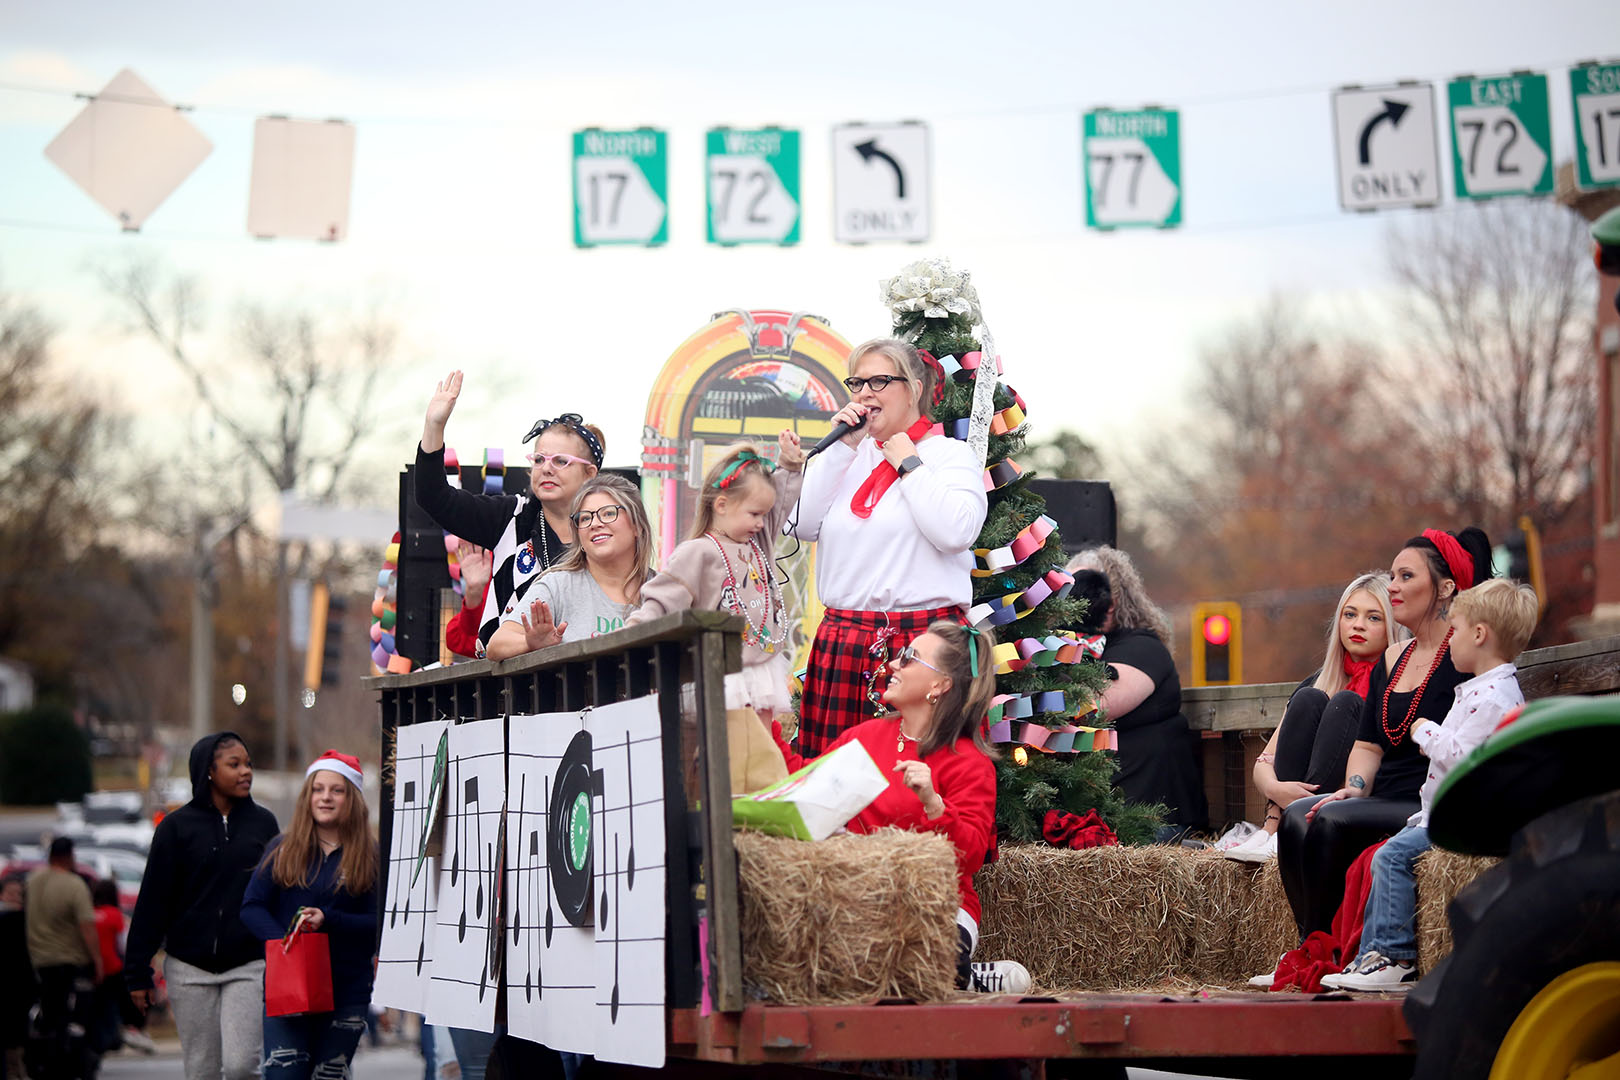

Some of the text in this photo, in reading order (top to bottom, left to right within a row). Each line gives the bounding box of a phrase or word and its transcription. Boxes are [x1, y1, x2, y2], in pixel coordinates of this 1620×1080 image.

[1470, 79, 1523, 105] EAST
[1095, 113, 1168, 137] NORTH
[583, 132, 657, 155] NORTH
[724, 132, 783, 155] WEST
[1461, 119, 1520, 176] 72
[1089, 153, 1145, 208] 77
[1352, 170, 1425, 199] ONLY
[588, 172, 629, 226] 17
[712, 170, 772, 225] 72
[846, 209, 918, 232] ONLY
